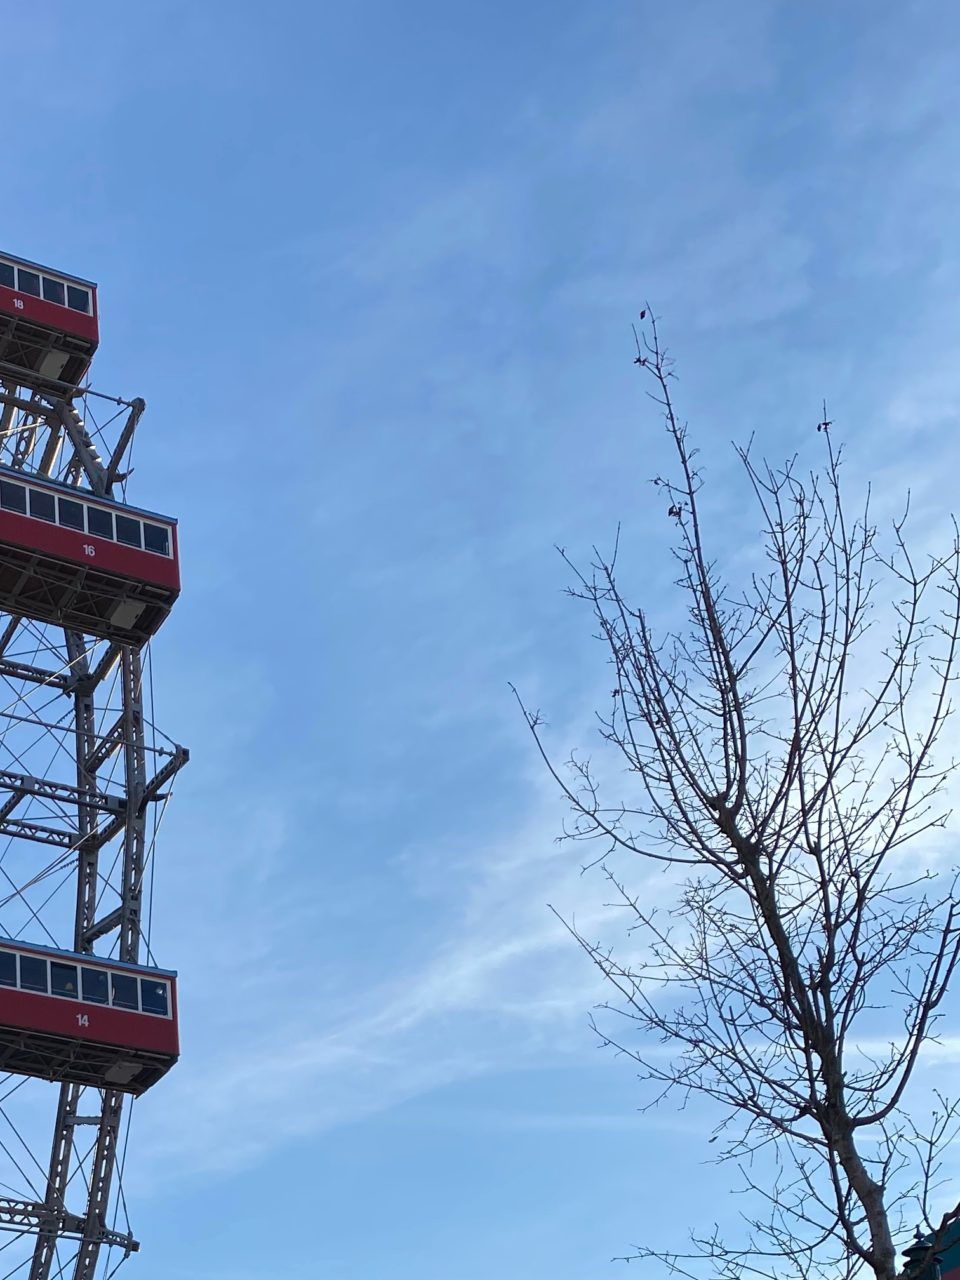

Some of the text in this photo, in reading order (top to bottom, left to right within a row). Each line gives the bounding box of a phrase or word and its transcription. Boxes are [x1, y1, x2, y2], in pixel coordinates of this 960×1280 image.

[12, 298, 24, 310] 18
[82, 543, 96, 557] 16
[75, 1013, 90, 1028] 14
